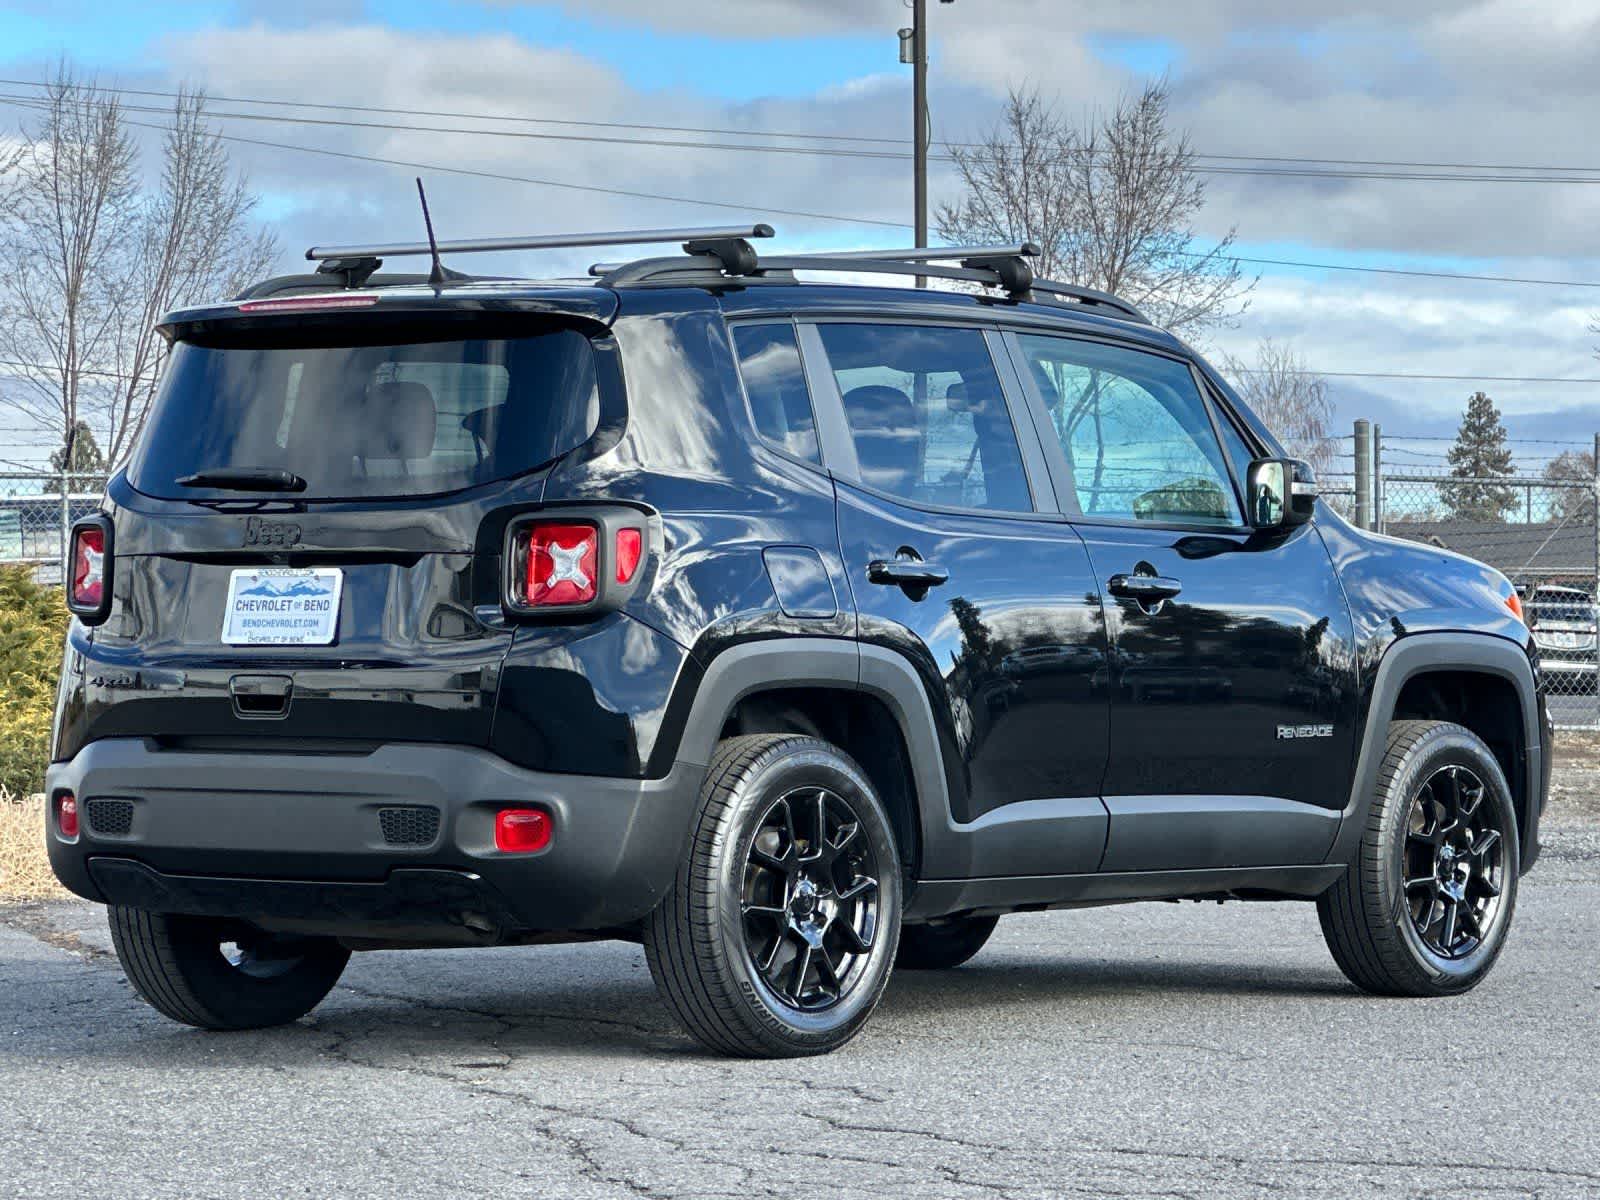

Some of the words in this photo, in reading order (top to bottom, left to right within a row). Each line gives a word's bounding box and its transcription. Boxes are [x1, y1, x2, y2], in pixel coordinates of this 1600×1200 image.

[245, 516, 302, 549] Jeep
[235, 599, 293, 611] CHEVROLET
[303, 599, 331, 611] BEND
[242, 618, 320, 628] BENDCHEVROLET.COM
[1276, 724, 1334, 739] RENEGADE
